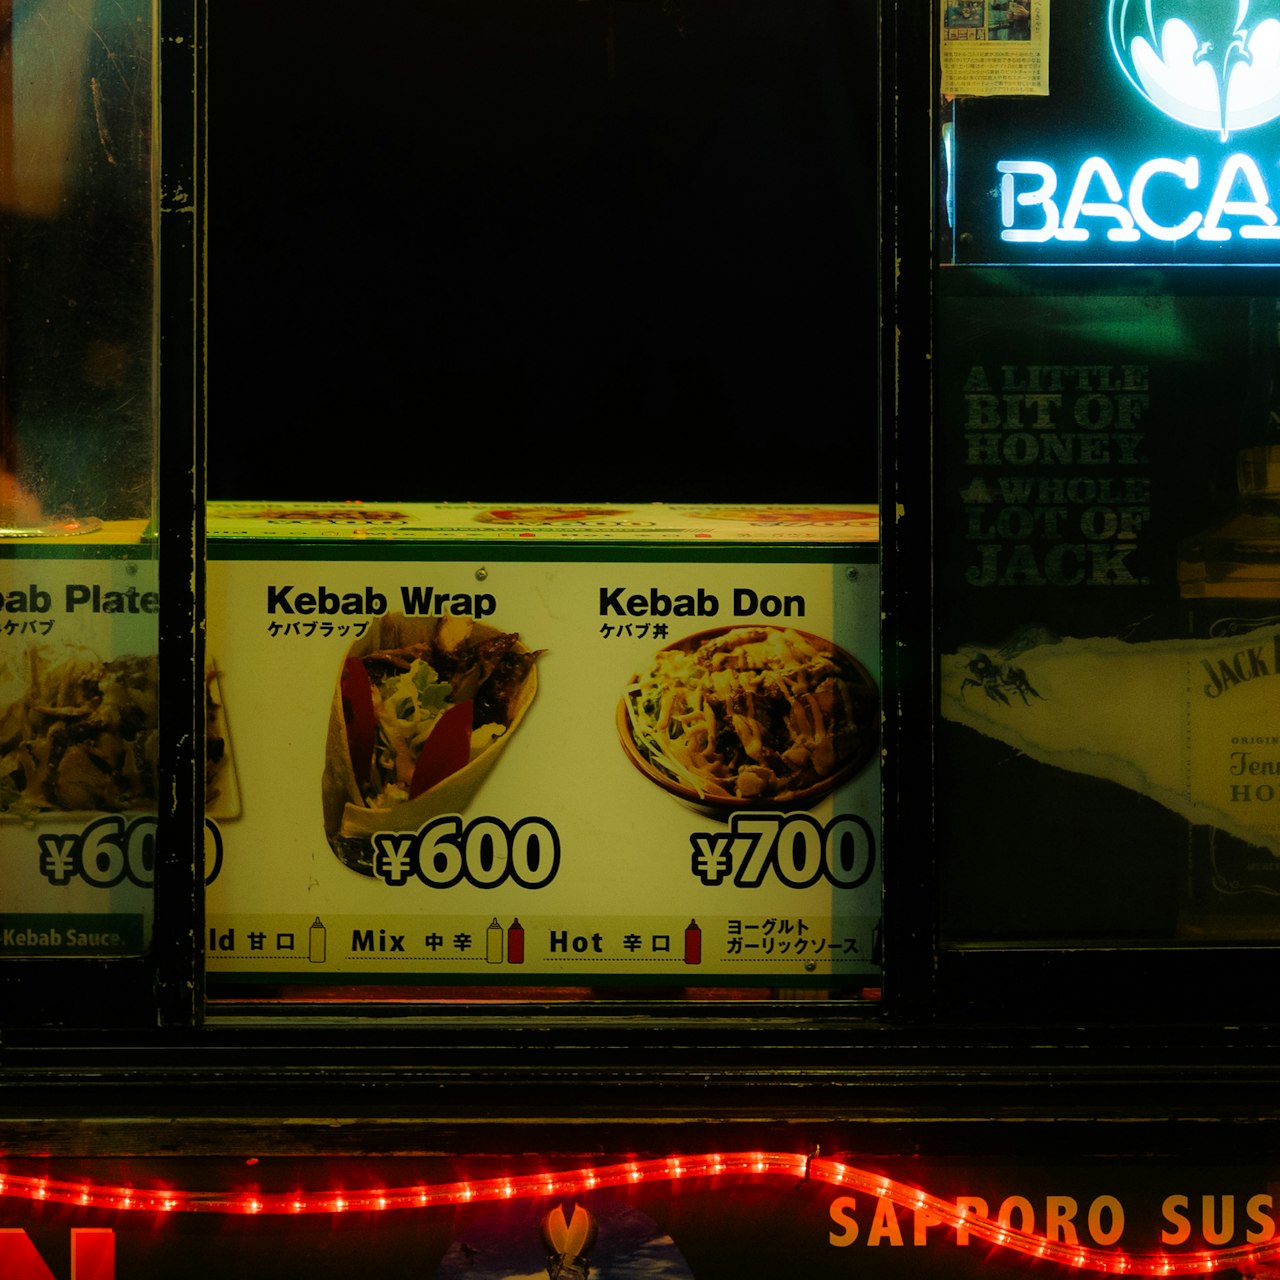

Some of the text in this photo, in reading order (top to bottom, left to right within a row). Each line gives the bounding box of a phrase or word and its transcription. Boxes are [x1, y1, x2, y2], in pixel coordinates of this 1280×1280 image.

[962, 365, 1151, 391] A LITTLE
[964, 393, 1151, 431] BIT OF
[961, 477, 1151, 504] A WHOLE
[966, 505, 1151, 541] LOT OF
[964, 544, 1151, 587] JACK.
[267, 586, 498, 620] Kebab Wrap
[599, 588, 806, 617] Kebab Don
[267, 621, 369, 639] ケバブラップ
[599, 622, 669, 640] ケバブ丼
[1202, 645, 1267, 699] JACK
[39, 816, 223, 889] ¥60
[373, 815, 562, 890] ¥600
[690, 813, 877, 890] ¥700
[208, 927, 671, 953] ld 甘口 Mix 中辛 Hot 辛口
[726, 918, 810, 936] ヨーグルト
[726, 936, 860, 955] ガーリックソース
[828, 1194, 1126, 1249] SAPPORO
